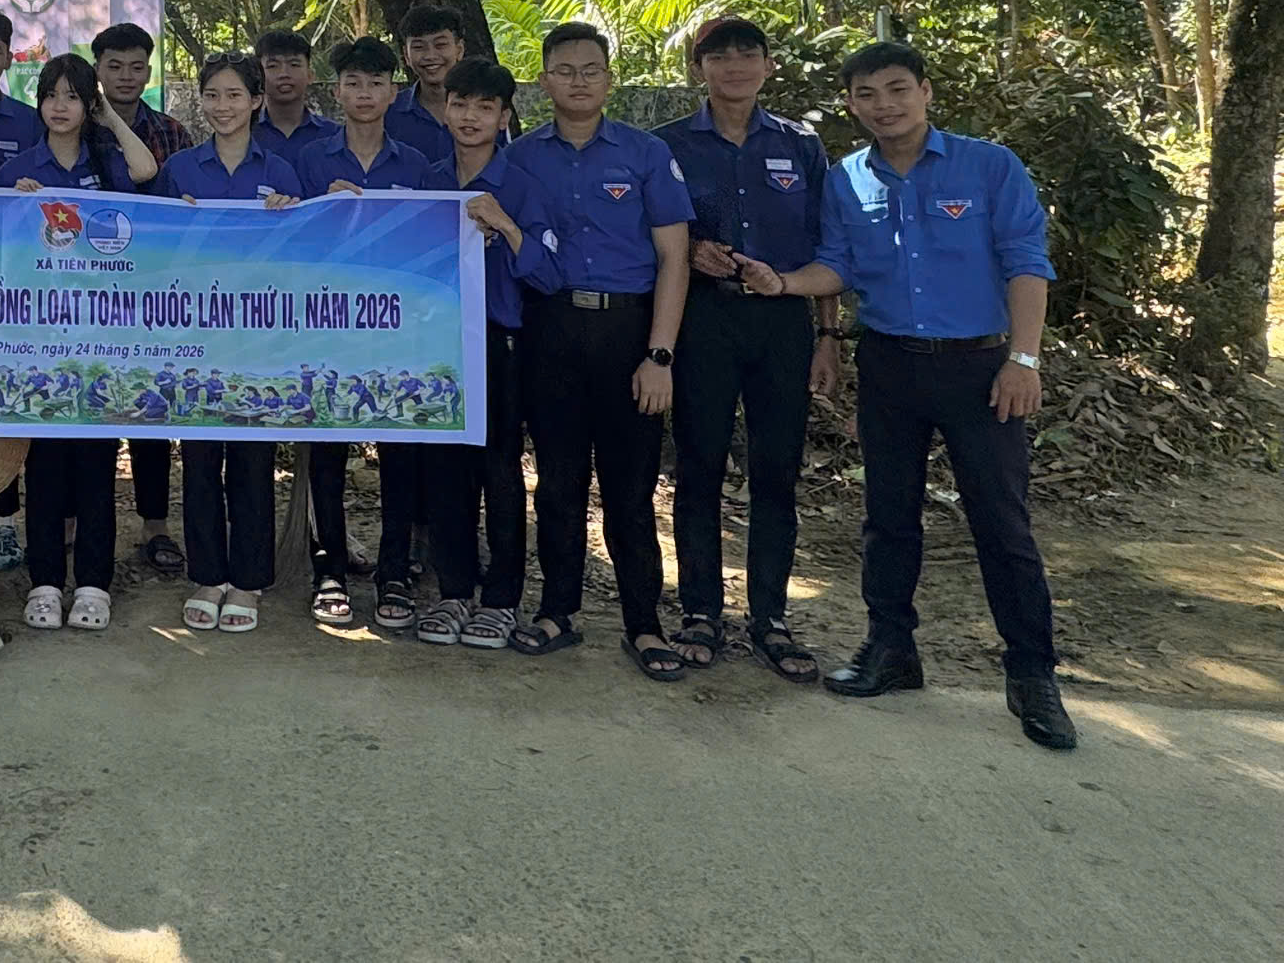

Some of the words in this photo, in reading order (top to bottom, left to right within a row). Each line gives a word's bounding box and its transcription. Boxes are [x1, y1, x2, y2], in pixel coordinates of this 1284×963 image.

[36, 258, 53, 270] XÃ
[58, 258, 86, 270] TIÊN
[91, 259, 134, 272] PHƯỚC
[38, 289, 82, 333] LOẠT
[88, 283, 136, 327] TOÀN
[142, 279, 192, 331] QUỐC
[198, 280, 234, 328] LẦN
[240, 285, 278, 329] THỨ
[282, 293, 299, 333] II,
[306, 285, 349, 329] NĂM
[355, 293, 401, 329] 2026
[42, 343, 72, 357] ngày
[75, 343, 90, 355] 24
[94, 343, 129, 359] tháng
[133, 344, 141, 356] 5
[144, 346, 171, 357] năm
[175, 345, 205, 358] 2026
